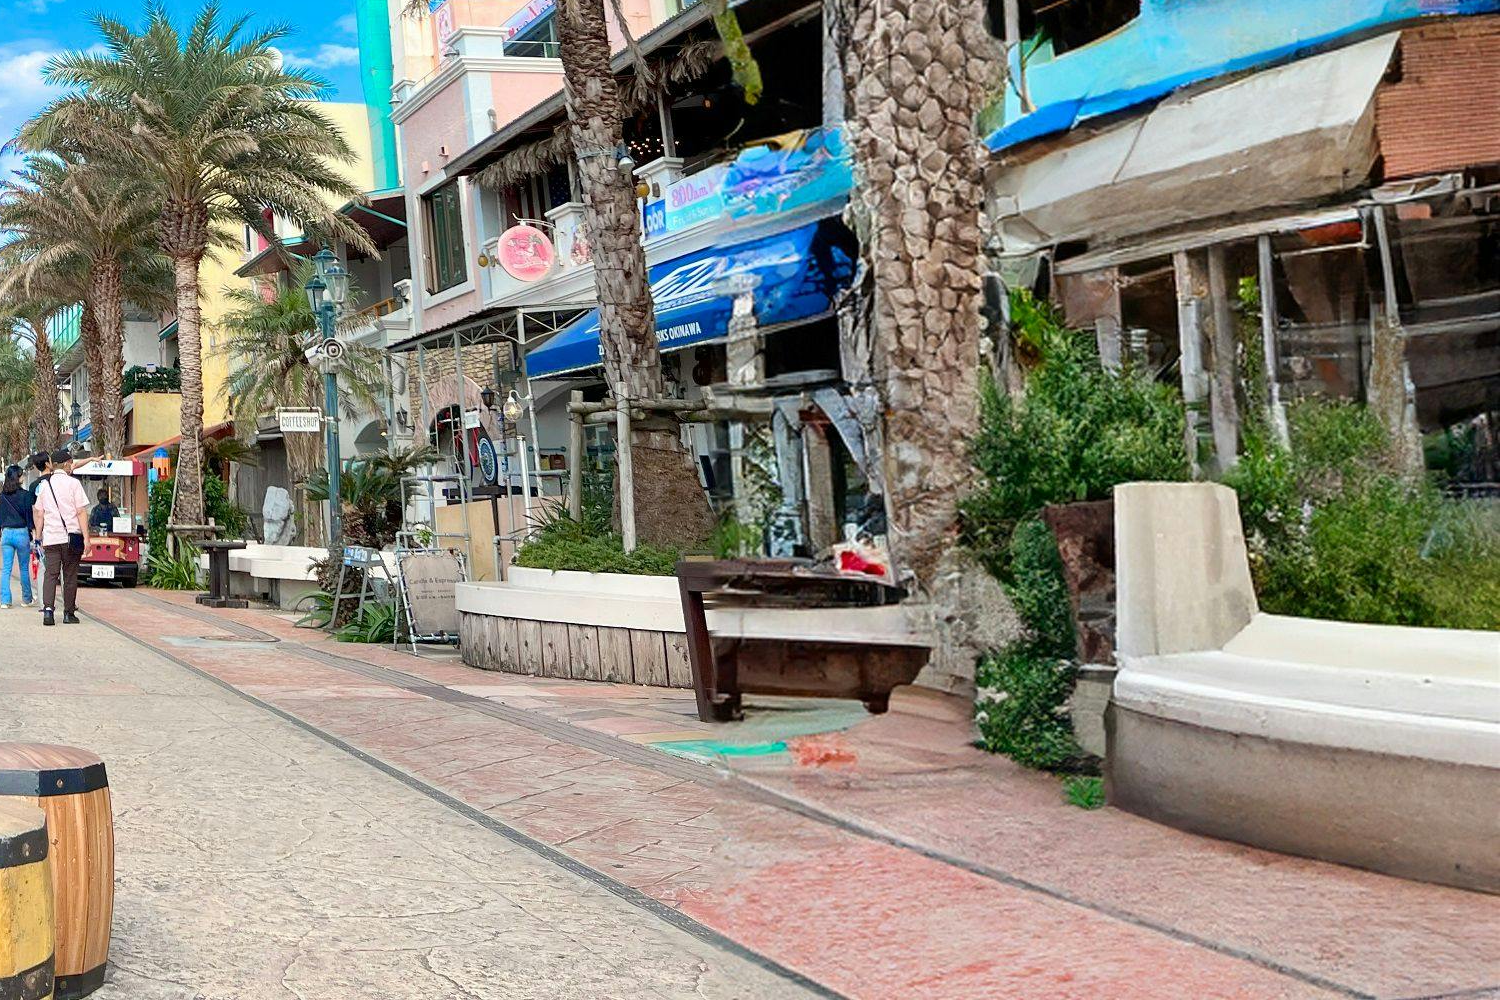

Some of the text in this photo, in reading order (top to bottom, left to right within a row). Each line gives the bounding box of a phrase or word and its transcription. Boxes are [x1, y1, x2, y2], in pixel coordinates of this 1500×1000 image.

[645, 210, 665, 232] OOR
[655, 321, 702, 341] RKS OKINAWA
